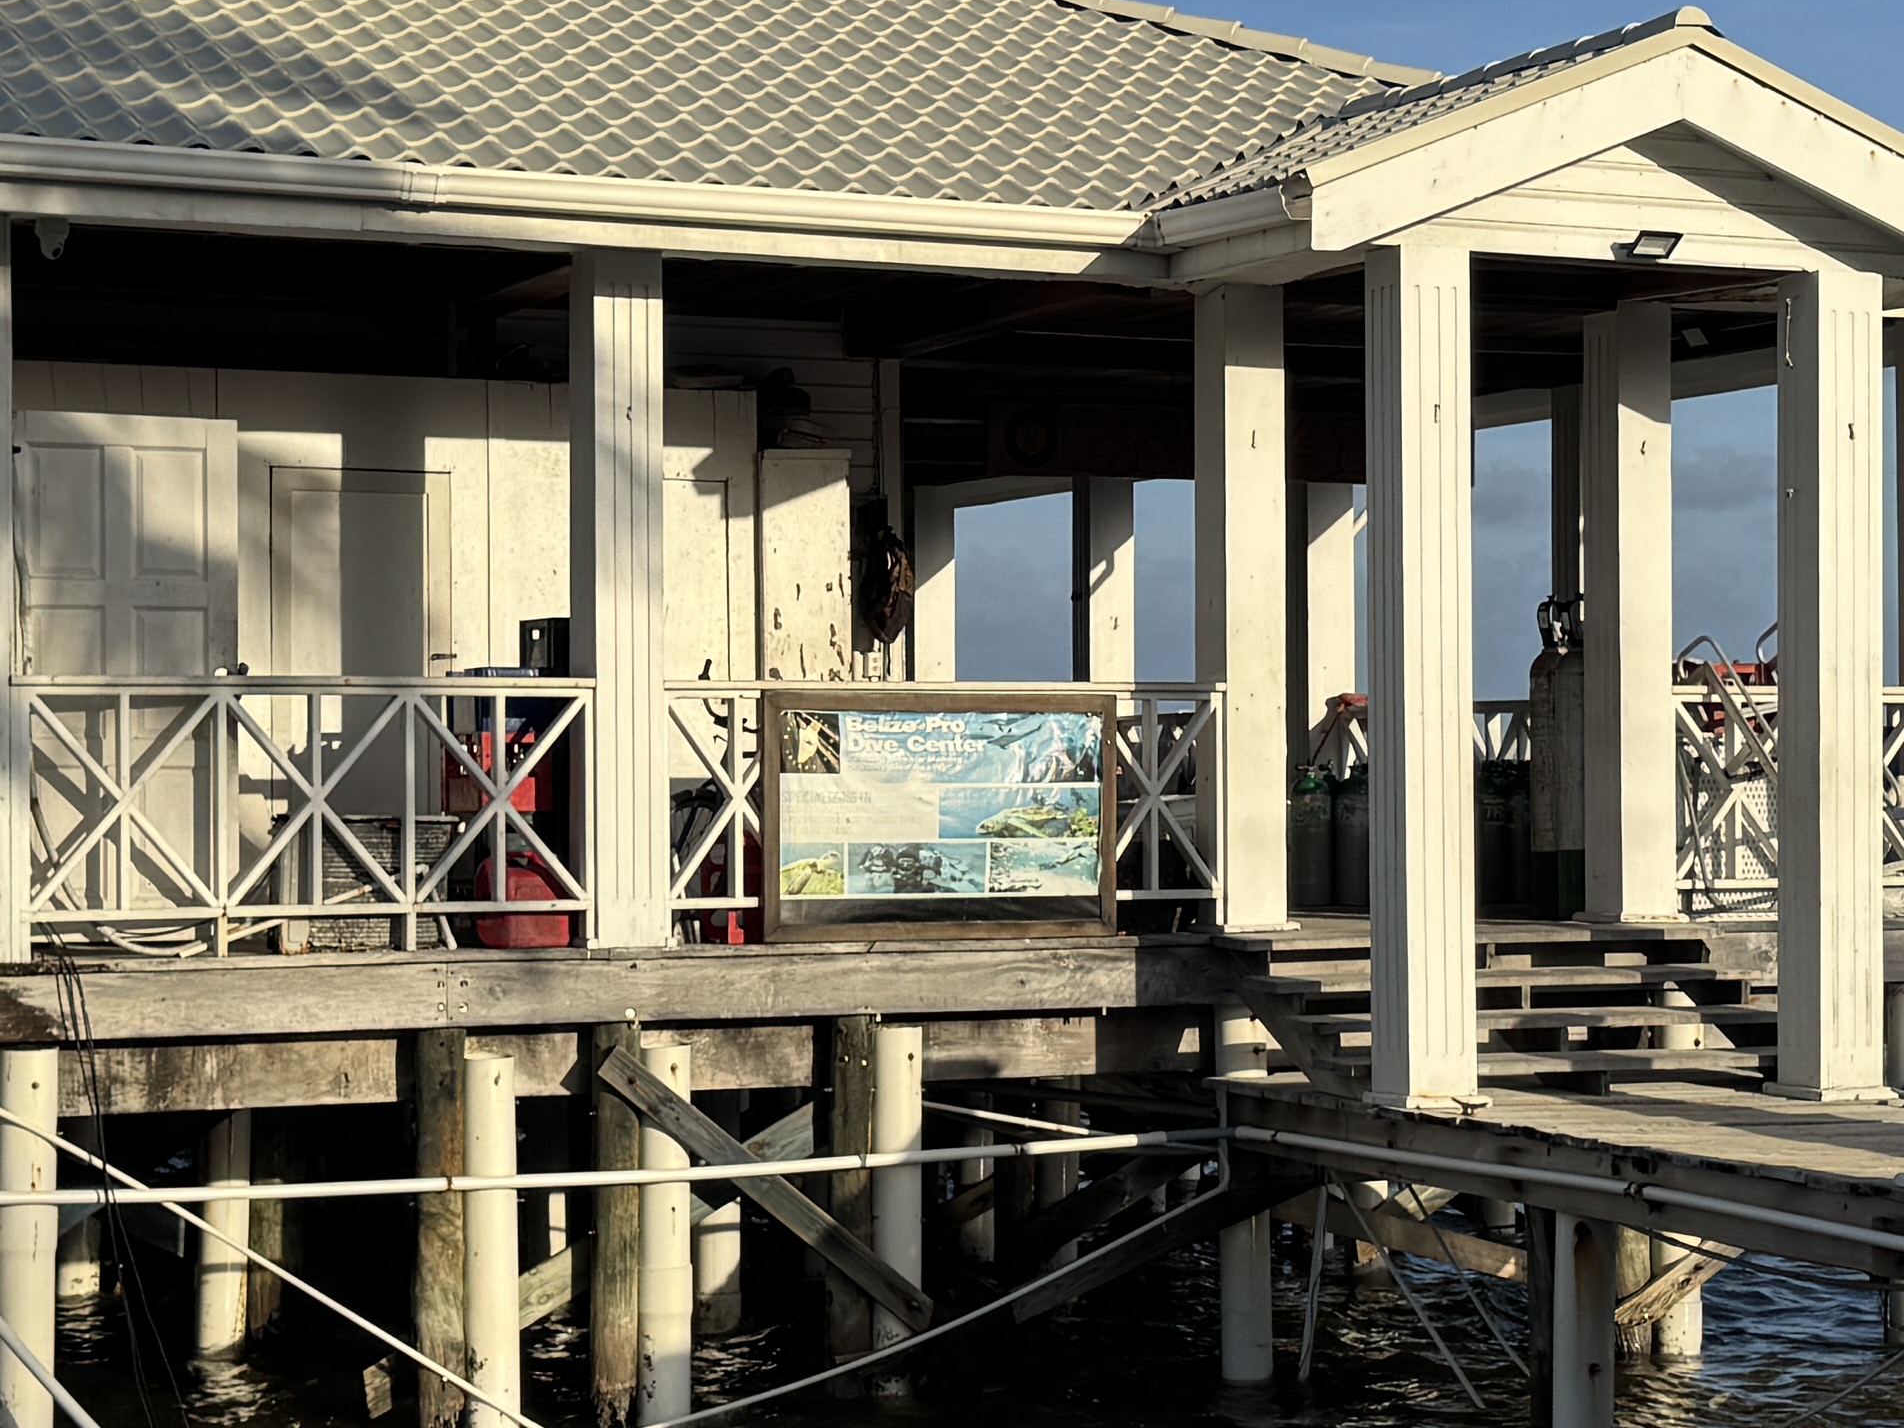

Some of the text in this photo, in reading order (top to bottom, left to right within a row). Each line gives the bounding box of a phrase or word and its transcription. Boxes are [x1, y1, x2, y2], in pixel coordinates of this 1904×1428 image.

[845, 714, 966, 733] Belize Pro
[847, 733, 988, 753] Dive Center
